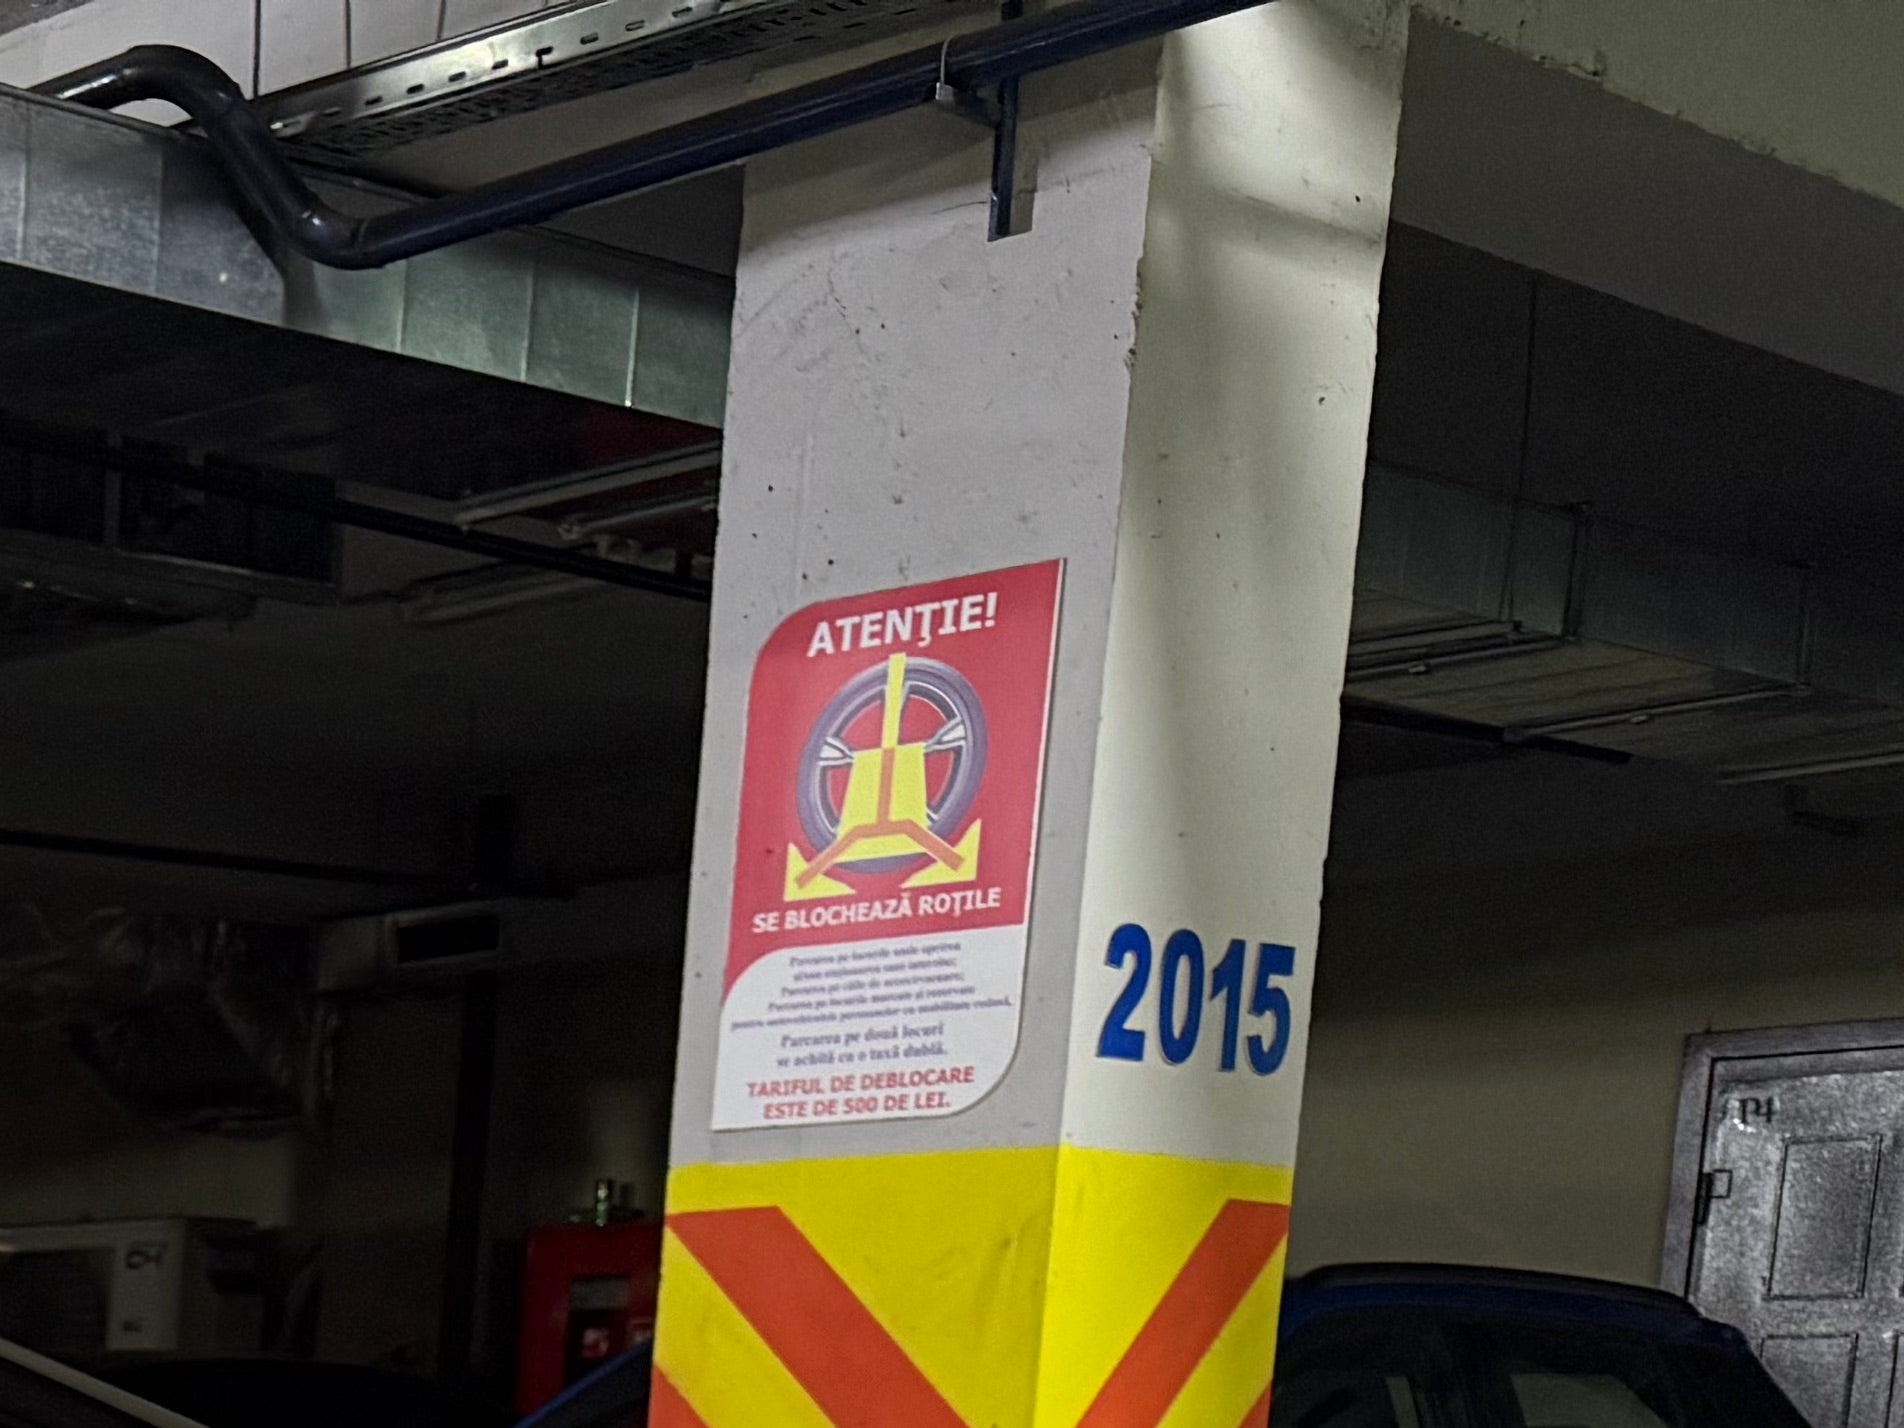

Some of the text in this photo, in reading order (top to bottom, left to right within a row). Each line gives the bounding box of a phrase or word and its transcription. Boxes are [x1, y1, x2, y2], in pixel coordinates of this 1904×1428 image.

[752, 911, 779, 933] SE
[784, 893, 912, 930] BLOCHEAZĂ
[1095, 921, 1297, 1077] 2015
[746, 1065, 975, 1098] TARIFUL DE DEBLOCARE
[763, 1090, 950, 1120] ESTE DE 500 DE LEI.
